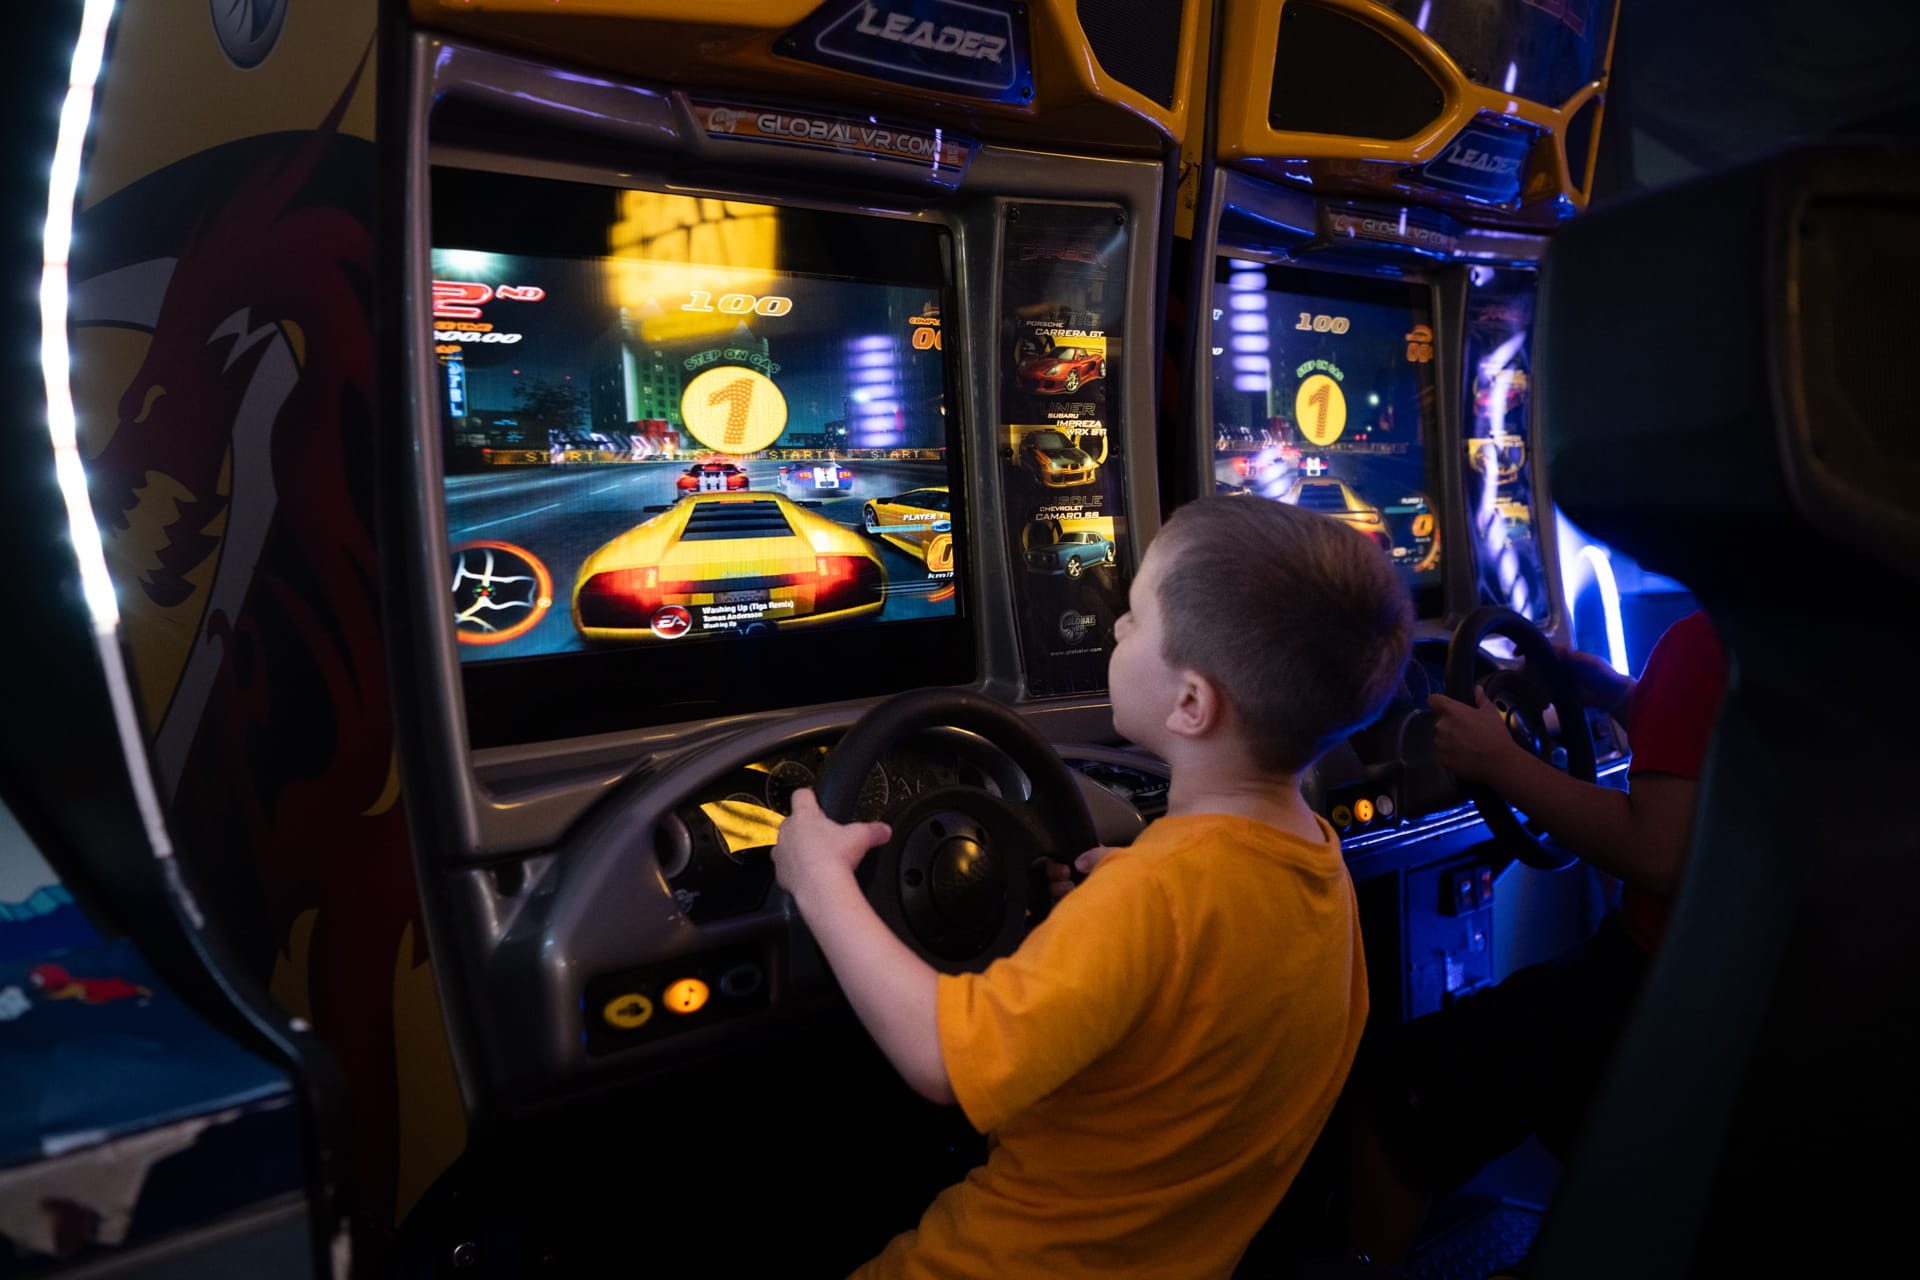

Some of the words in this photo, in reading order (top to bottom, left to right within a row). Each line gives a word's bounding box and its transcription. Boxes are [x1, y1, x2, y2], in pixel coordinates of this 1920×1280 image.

[856, 4, 1007, 64] LEADER
[681, 291, 793, 317] 100
[1296, 313, 1350, 334] 100
[912, 327, 942, 350] 0
[1035, 328, 1087, 338] CARRERA
[1089, 330, 1104, 338] GT
[683, 349, 721, 371] STEP
[723, 348, 749, 360] ON
[750, 353, 781, 374] GAS
[708, 377, 755, 445] 1
[1309, 384, 1331, 439] 1
[1056, 419, 1102, 428] IMPREZA
[1066, 428, 1089, 436] WRX
[903, 513, 937, 521] PLAYER
[1035, 511, 1082, 521] CAMARO
[702, 604, 736, 615] Washing
[737, 603, 748, 613] Up
[656, 614, 687, 629] EA
